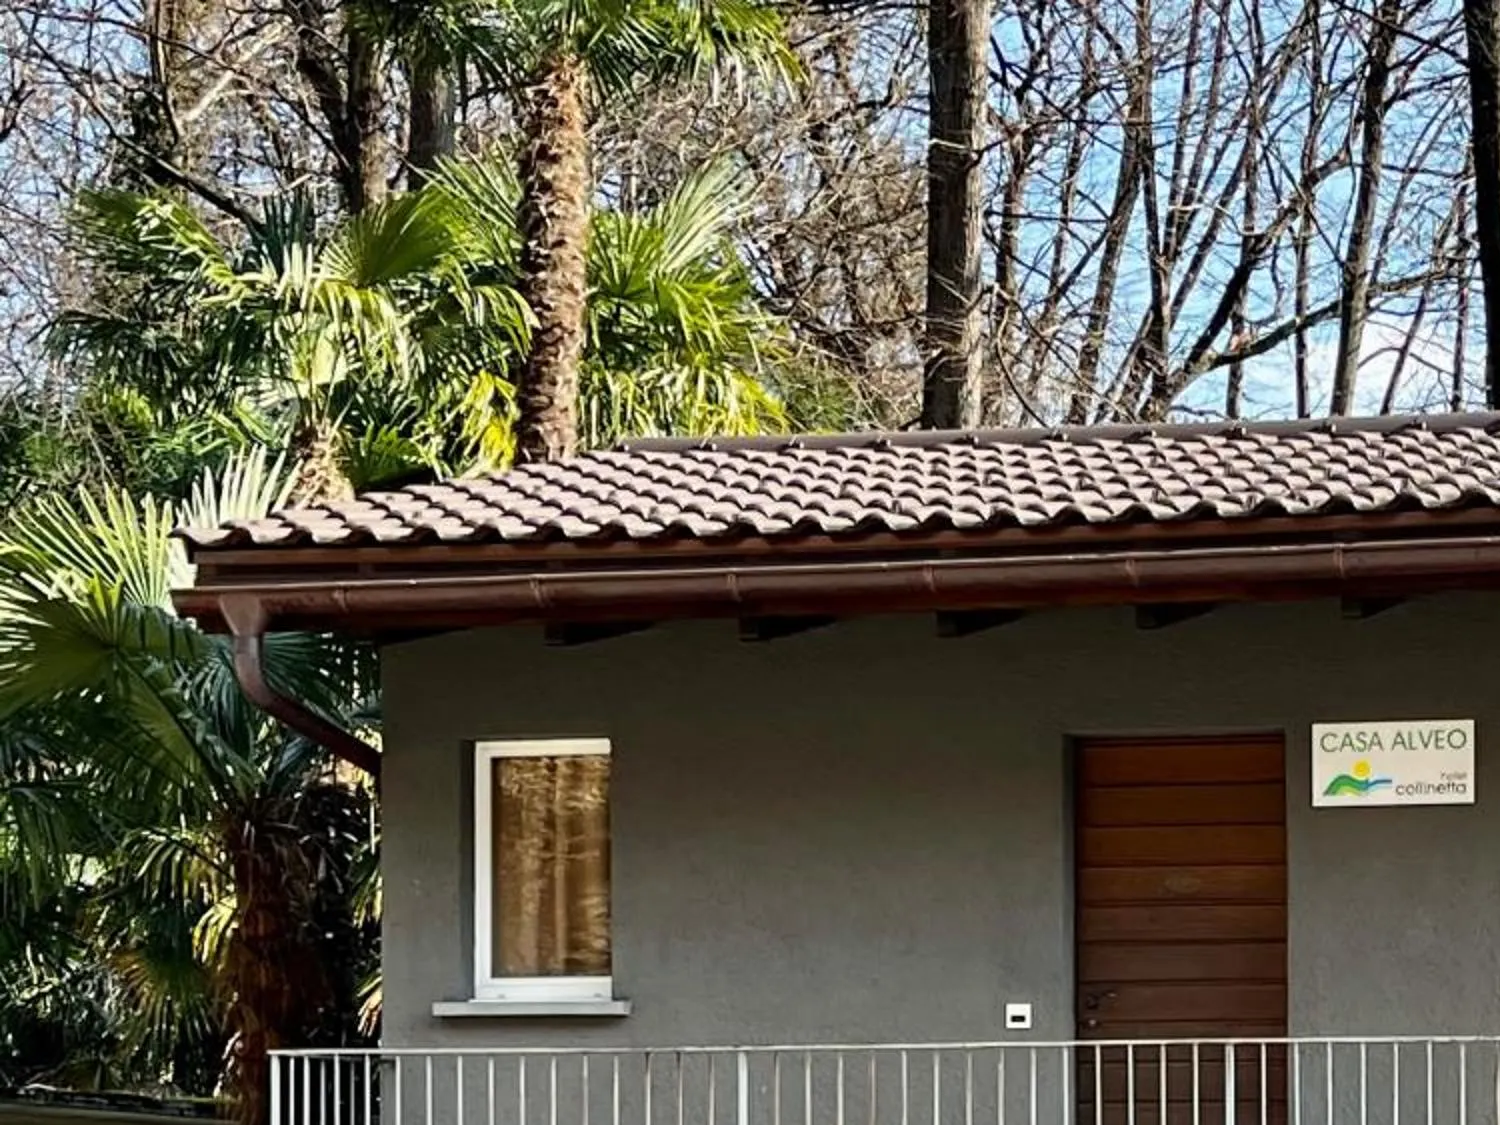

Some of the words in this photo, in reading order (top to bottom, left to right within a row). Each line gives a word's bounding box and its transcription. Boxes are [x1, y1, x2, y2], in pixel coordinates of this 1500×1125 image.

[1319, 730, 1385, 753] CASA
[1391, 728, 1468, 751] ALVEO
[1395, 780, 1468, 796] collinetta
